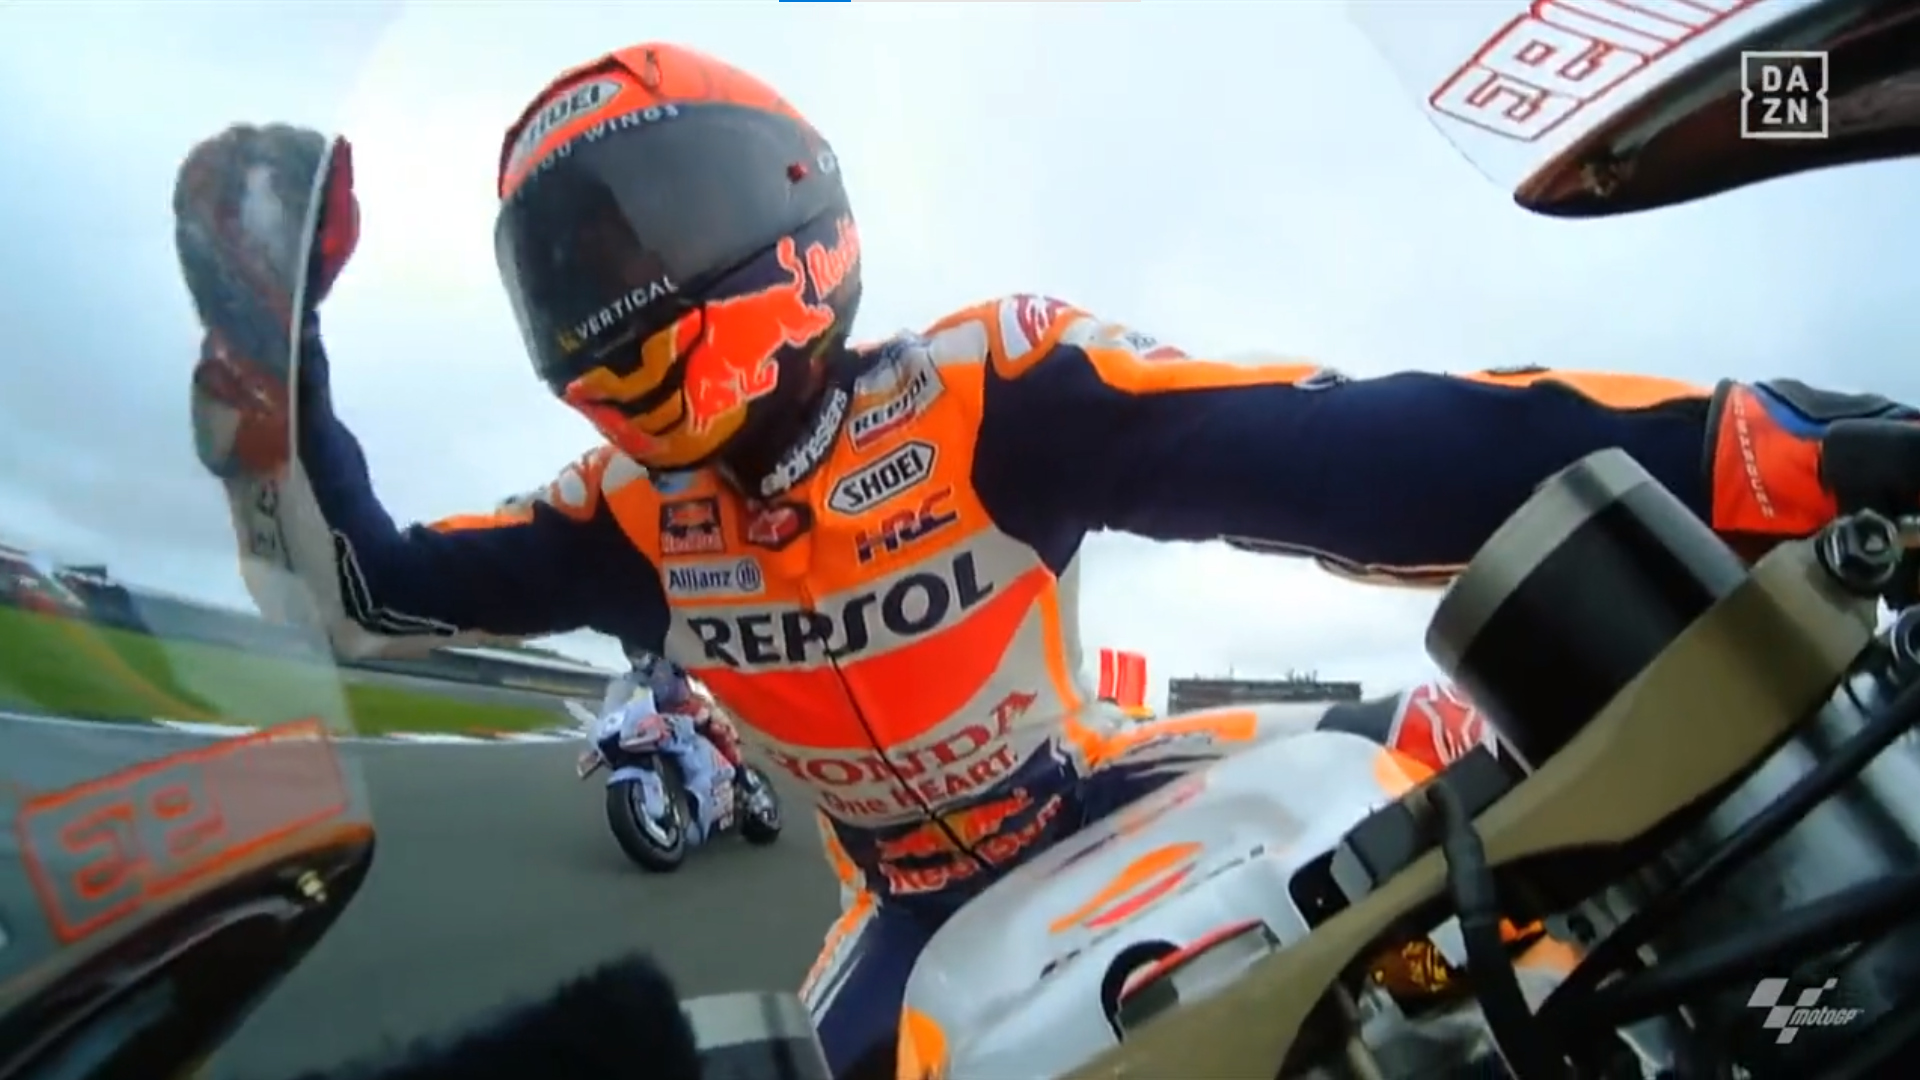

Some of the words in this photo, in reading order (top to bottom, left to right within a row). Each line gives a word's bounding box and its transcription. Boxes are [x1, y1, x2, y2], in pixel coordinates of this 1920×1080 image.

[584, 103, 679, 143] WINGS
[574, 274, 680, 340] VERTICAL
[761, 387, 848, 496] alpinestars
[842, 447, 924, 508] SHOEI
[854, 488, 959, 564] HRC
[668, 566, 732, 591] Allianz
[687, 551, 995, 667] REPSOL
[822, 791, 888, 815] One
